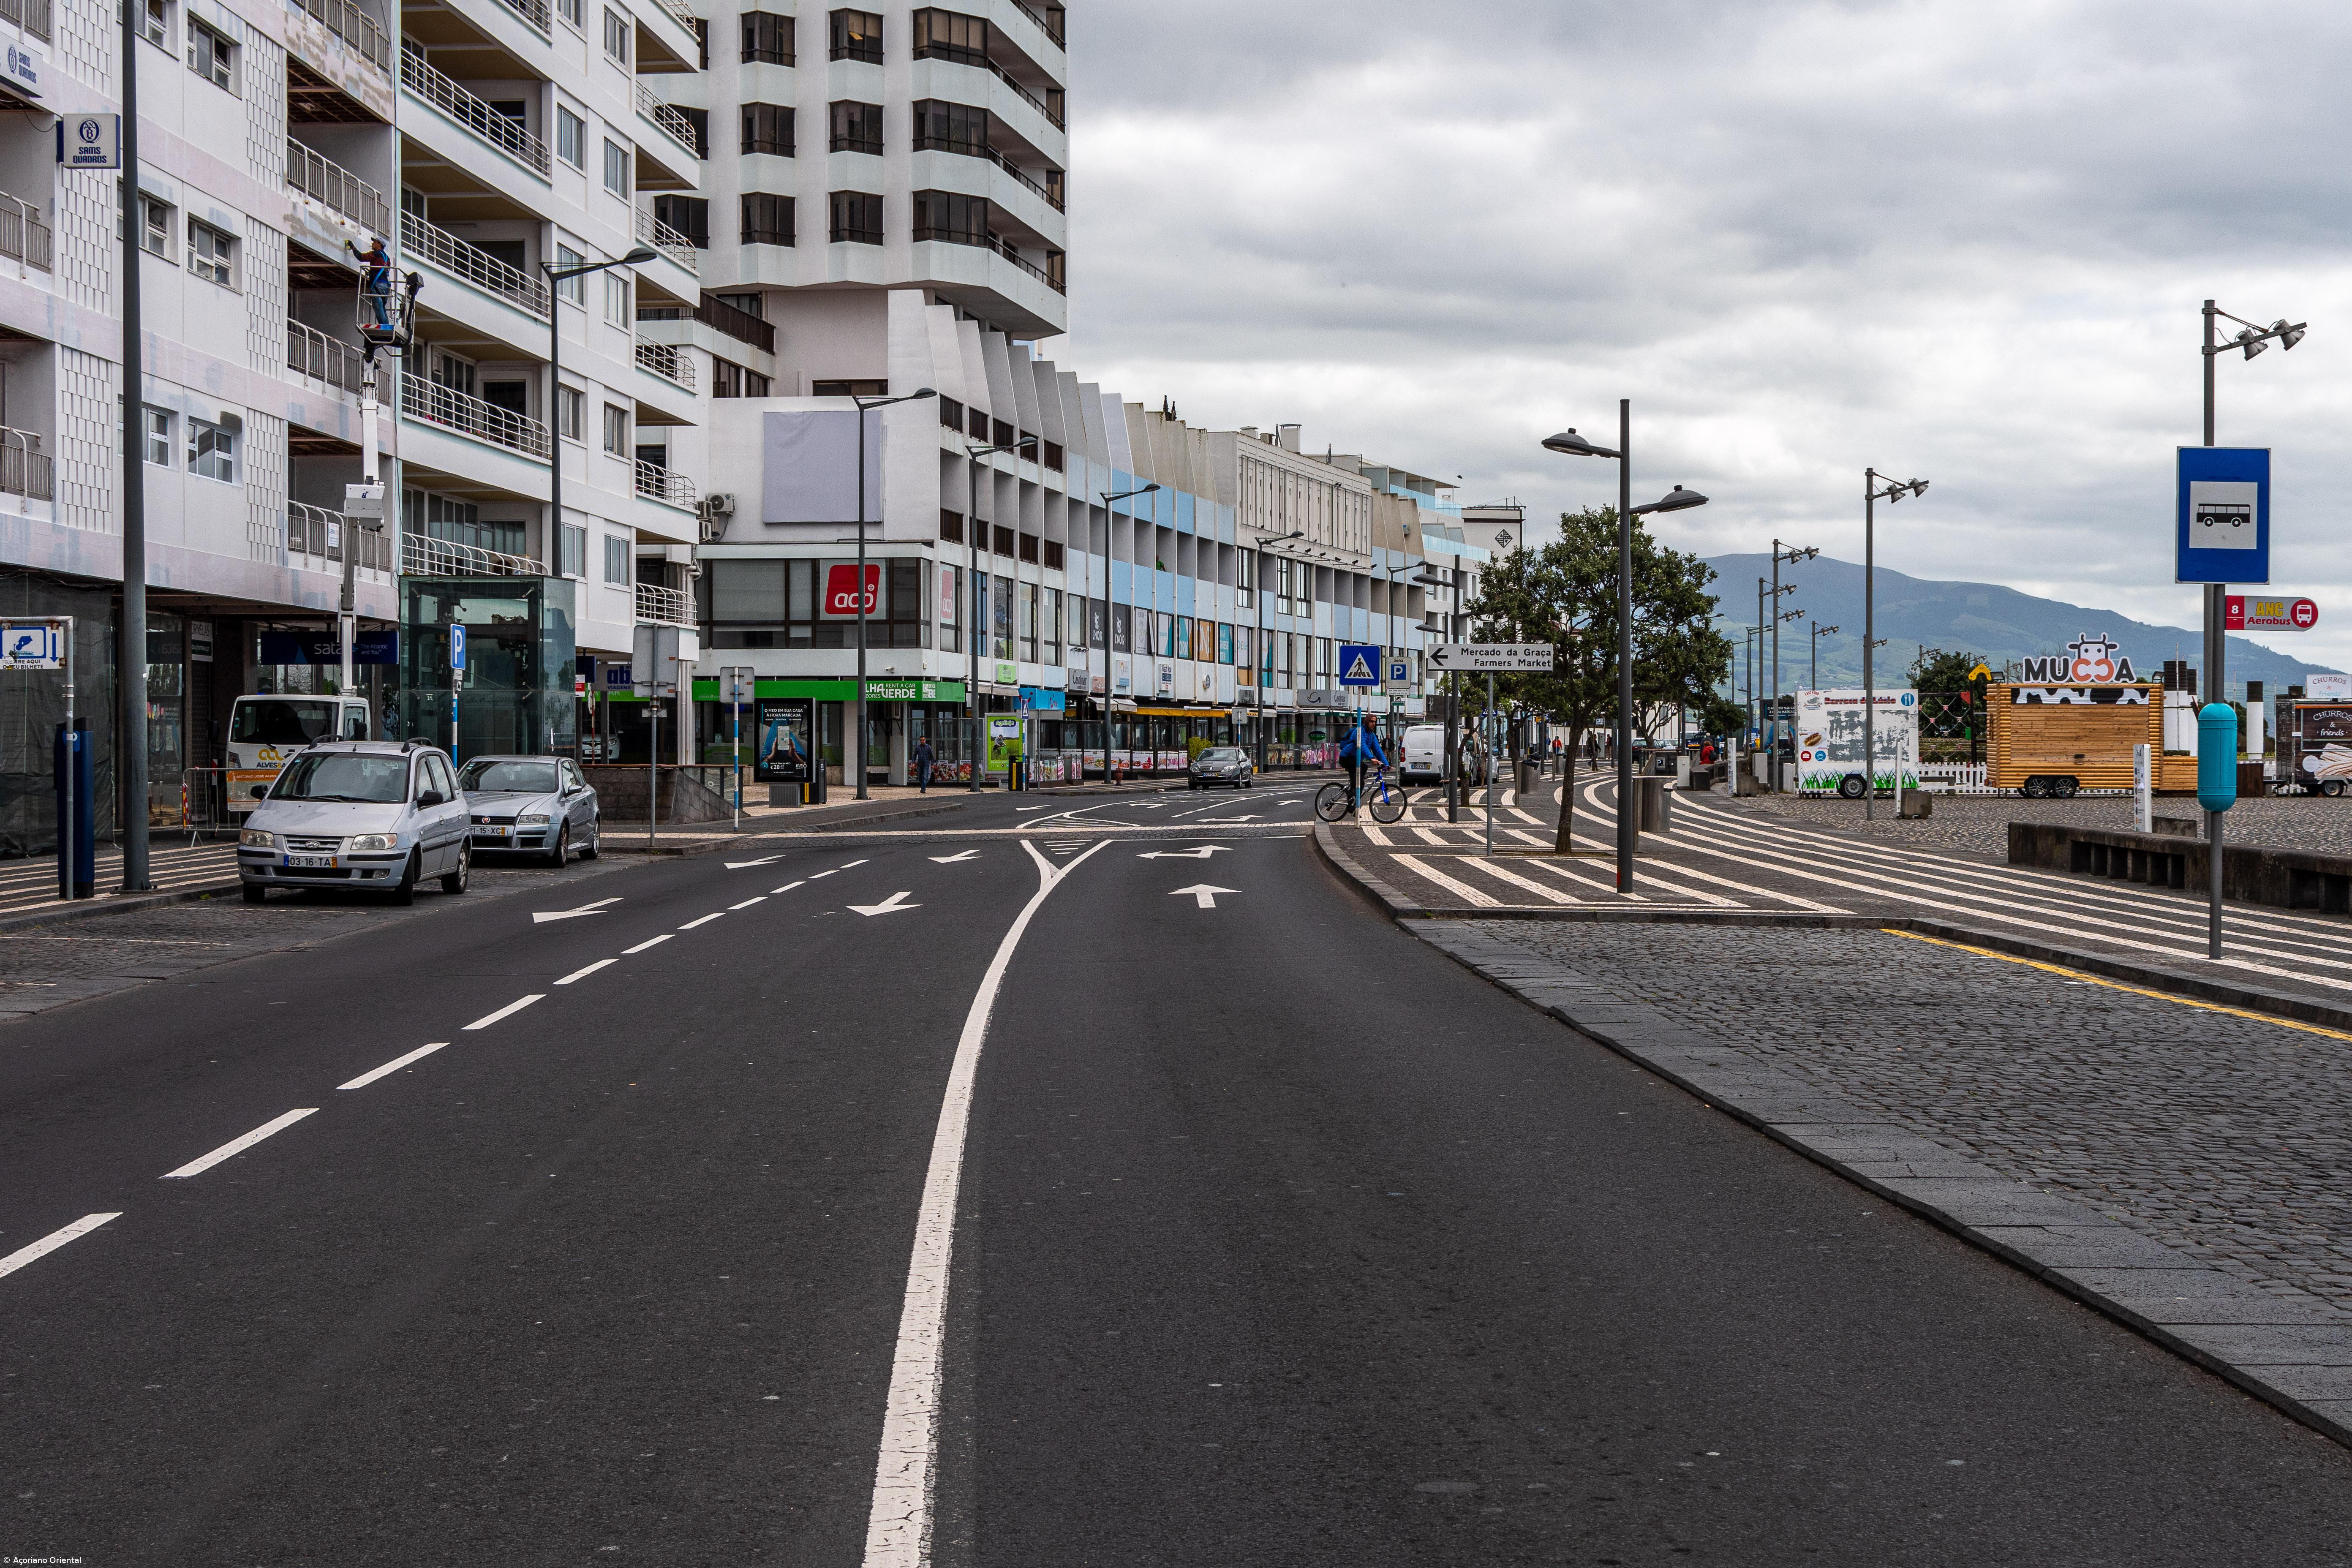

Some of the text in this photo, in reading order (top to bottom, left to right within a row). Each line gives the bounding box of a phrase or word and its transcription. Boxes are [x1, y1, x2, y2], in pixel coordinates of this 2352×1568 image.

[19, 52, 30, 68] SAMS
[19, 66, 37, 84] QUADROS
[79, 146, 101, 155] SAMS
[73, 155, 107, 164] QUADROS
[943, 598, 952, 615] acp
[2231, 605, 2239, 614] 8
[2255, 601, 2284, 617] ANC
[2246, 616, 2291, 625] Aerobus
[314, 641, 342, 655] sata
[455, 629, 463, 664] P
[1461, 648, 1501, 656] Mercado
[1524, 648, 1551, 658] Graça
[1394, 665, 1403, 678] P
[2313, 676, 2347, 685] CHURROS
[866, 683, 884, 693] LHA
[881, 689, 916, 698] VERDE
[2313, 710, 2352, 721] CHURROS
